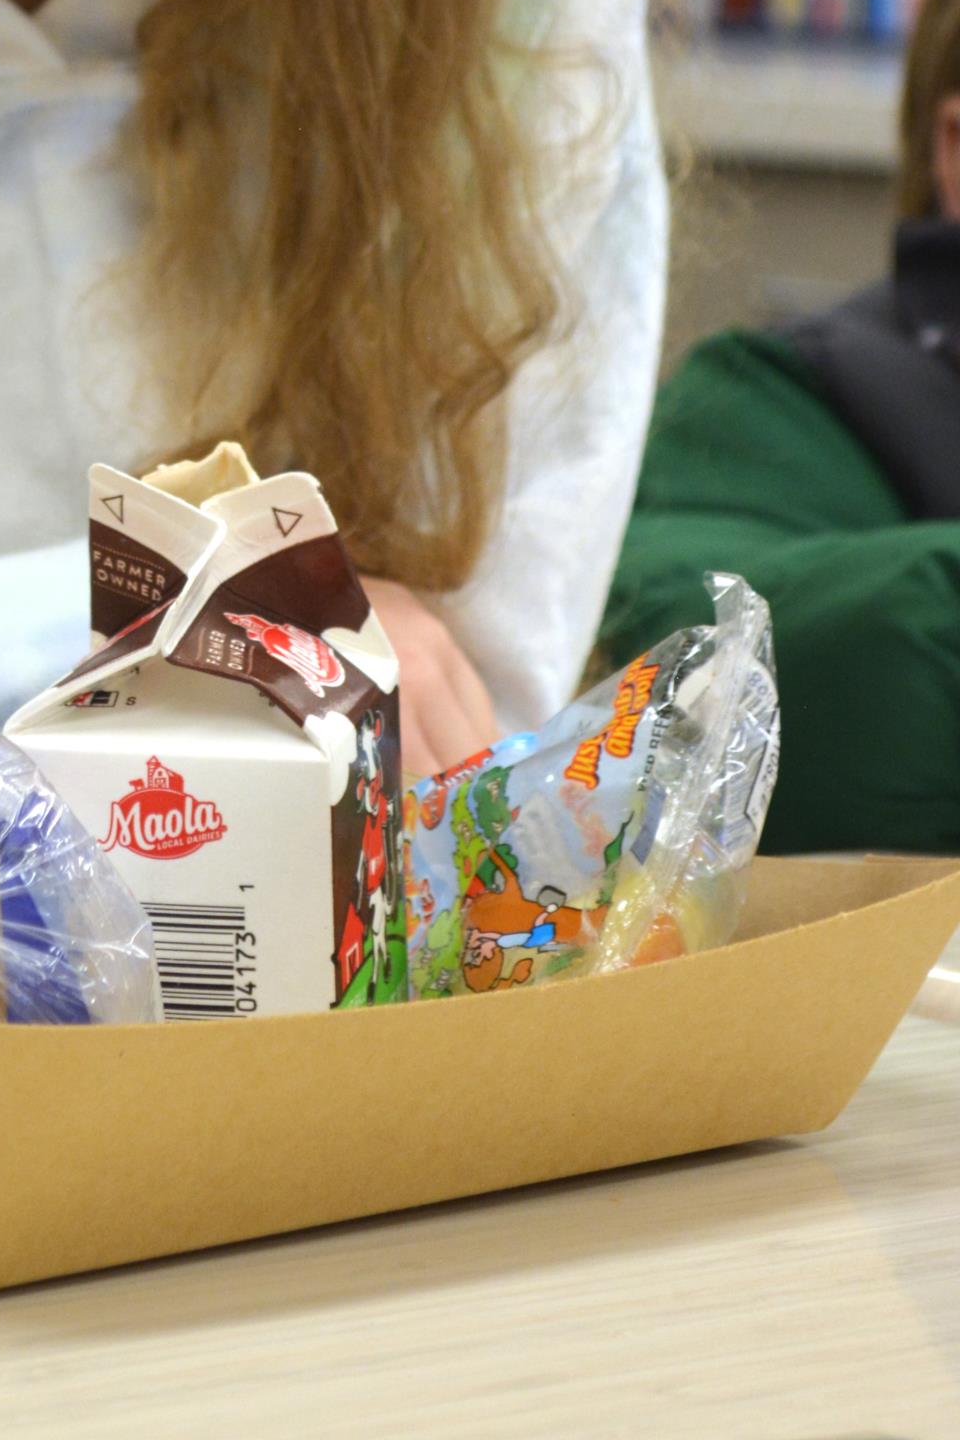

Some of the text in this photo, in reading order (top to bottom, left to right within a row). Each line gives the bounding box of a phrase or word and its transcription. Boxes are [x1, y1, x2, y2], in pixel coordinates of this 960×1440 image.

[93, 550, 166, 590] FARMER
[95, 568, 162, 601] OWNED
[205, 629, 227, 666] FARMER
[227, 638, 246, 671] OWNED
[125, 696, 137, 706] S
[604, 712, 640, 758] and
[97, 794, 223, 851] Maola
[157, 830, 222, 850] LOCAL DAIRIES
[235, 931, 257, 1013] 04173
